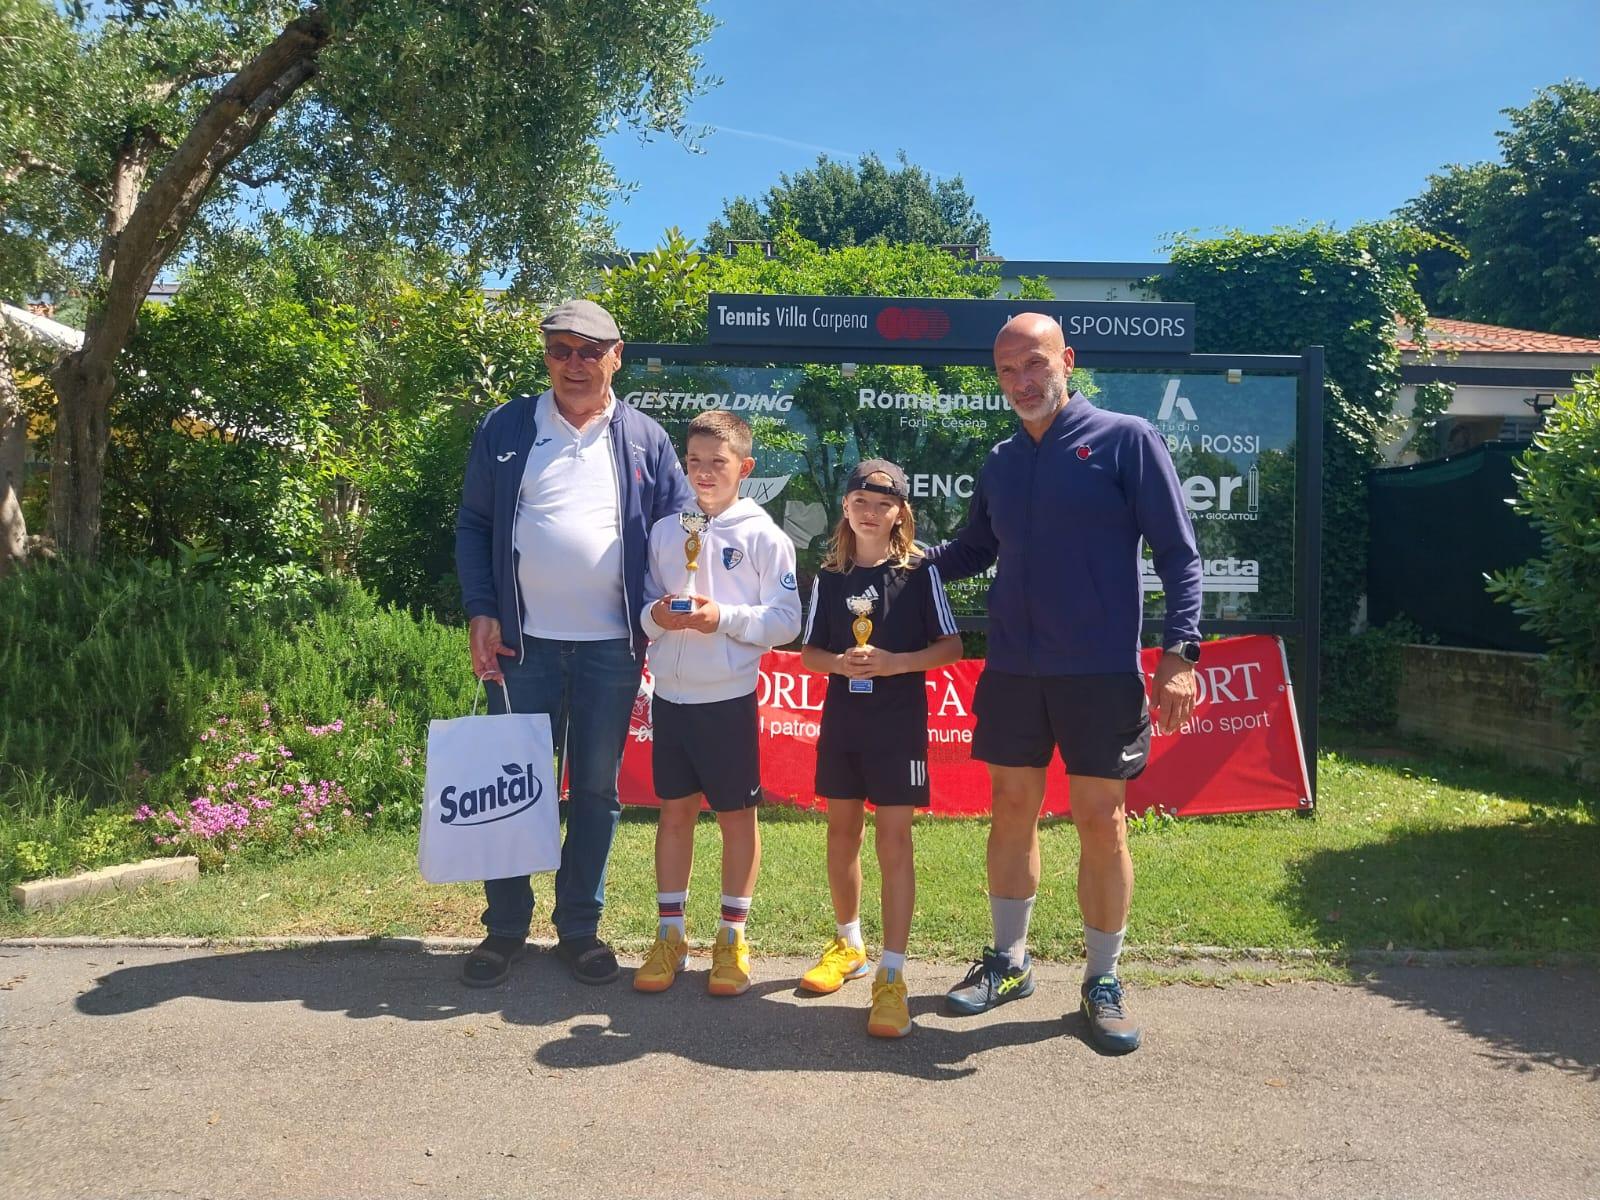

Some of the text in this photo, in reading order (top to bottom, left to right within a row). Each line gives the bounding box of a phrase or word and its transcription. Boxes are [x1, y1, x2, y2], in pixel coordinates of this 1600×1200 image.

[717, 306, 868, 333] Tennis Villa Carpena
[1070, 315, 1185, 337] SPONSORS
[623, 391, 794, 412] GESTHOLDING
[858, 388, 1014, 414] Romagnaut
[941, 417, 987, 429] Cesena
[1166, 434, 1260, 454] DA ROSSI
[905, 474, 975, 498] ENC
[1206, 512, 1258, 520] GIOCATTOLI
[770, 719, 821, 739] patro
[927, 728, 973, 743] mune
[1180, 716, 1213, 735] allo
[1219, 711, 1271, 736] sport
